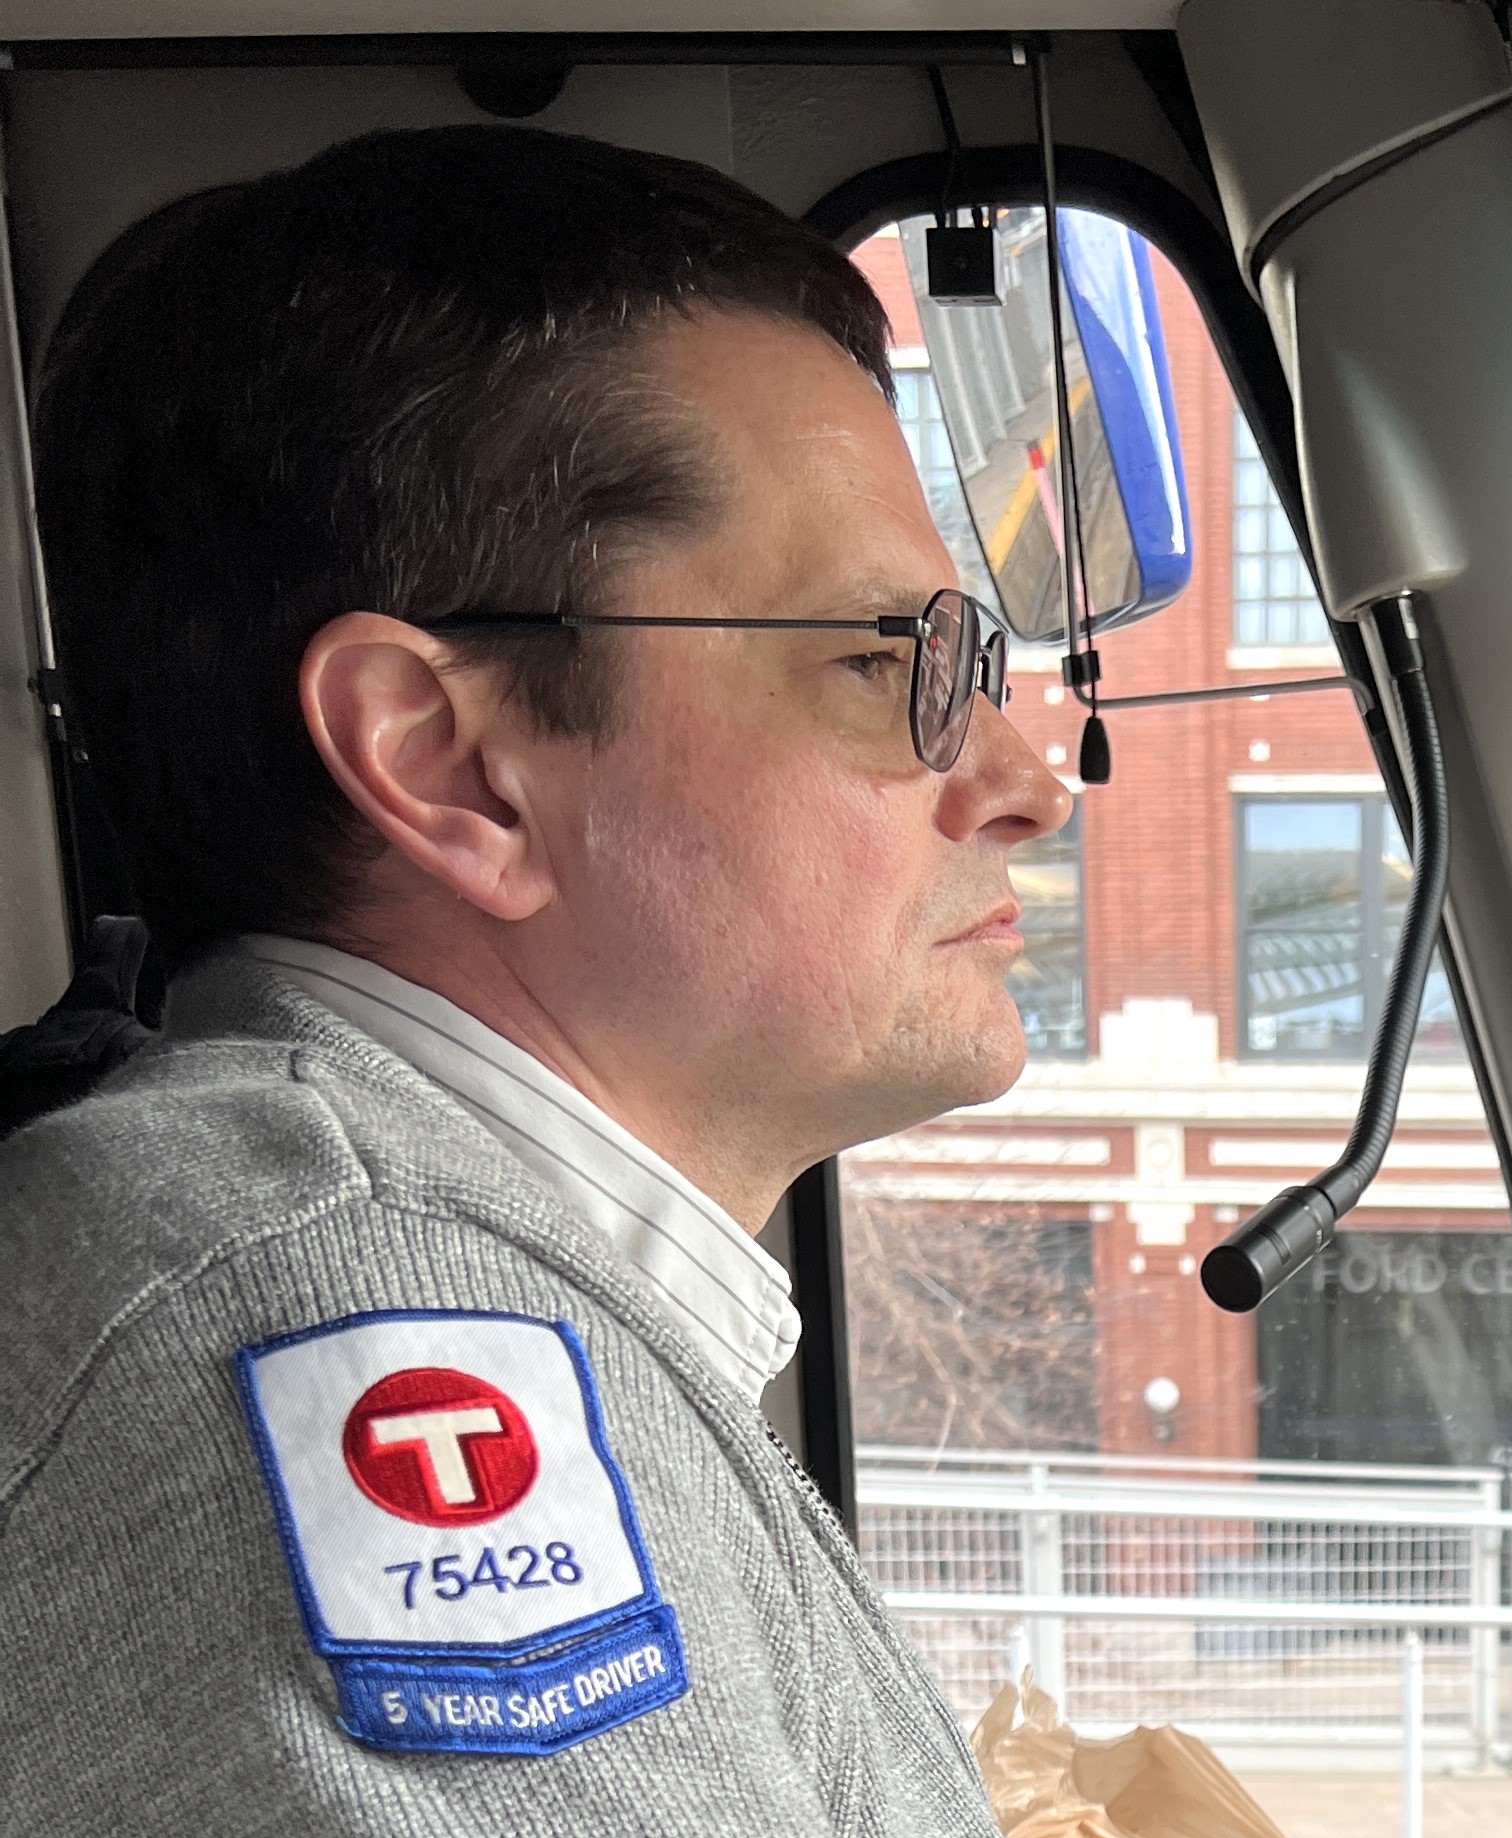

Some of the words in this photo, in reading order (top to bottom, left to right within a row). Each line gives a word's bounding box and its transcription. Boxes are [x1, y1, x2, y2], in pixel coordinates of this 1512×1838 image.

[1312, 1252, 1447, 1294] FORD
[369, 1407, 503, 1503] T
[385, 1542, 583, 1610] 75428
[382, 1693, 407, 1724] 5
[423, 1695, 504, 1728] YEAR
[507, 1682, 574, 1729] SAFE
[574, 1645, 666, 1706] DRIVER
